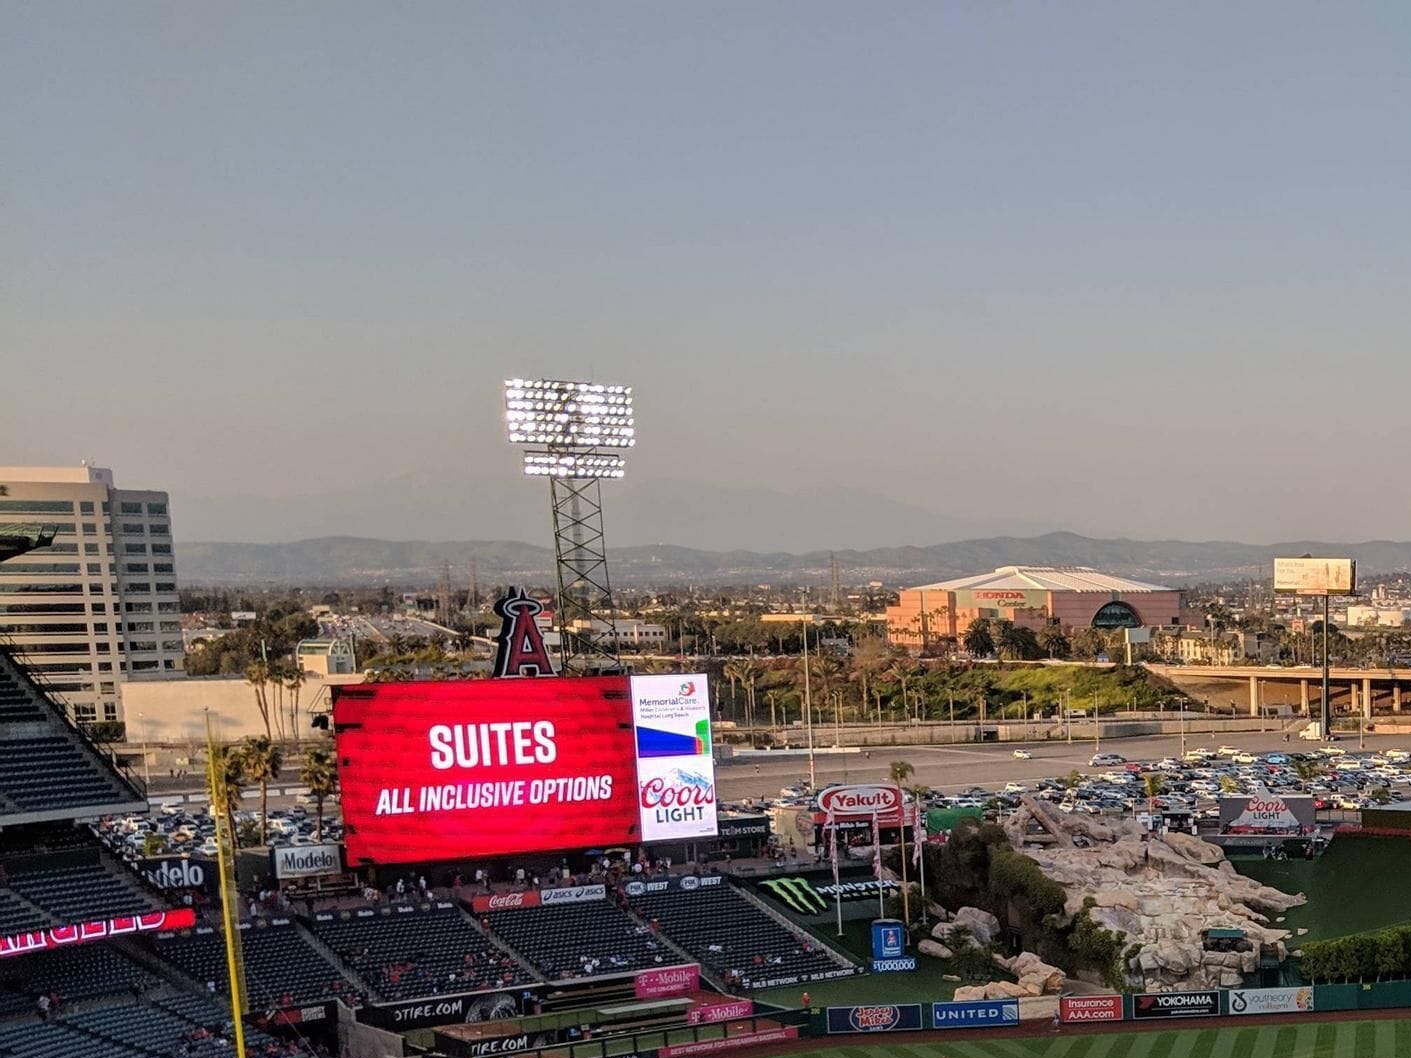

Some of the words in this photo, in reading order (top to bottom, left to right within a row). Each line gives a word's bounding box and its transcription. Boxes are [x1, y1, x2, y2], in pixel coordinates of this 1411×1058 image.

[997, 599, 1026, 607] Center
[639, 696, 697, 707] MemorialCare
[429, 720, 557, 770] SUITES
[376, 787, 414, 816] ALL
[419, 779, 524, 812] INCLUSIVE
[529, 774, 613, 805] OPTIONS
[640, 777, 714, 810] Coors
[834, 792, 892, 807] Yakult
[1246, 795, 1289, 812] Coors
[656, 806, 705, 824] LIGHT
[1253, 812, 1280, 820] LIGHT
[721, 827, 741, 837] TEAM
[743, 825, 766, 834] STORE
[283, 851, 333, 870] Modelo
[647, 881, 668, 892] WEST
[701, 876, 722, 886] WEST
[811, 972, 824, 981] MLB
[825, 969, 855, 978] NETWORK
[753, 980, 767, 989] MLB
[768, 976, 798, 988] NETWORK
[1068, 999, 1114, 1009] Insurance
[1157, 995, 1213, 1007] YOKOHAMA
[856, 1006, 893, 1019] Jersey
[936, 1008, 998, 1020] UNITED
[1068, 1009, 1115, 1020] AAA.com
